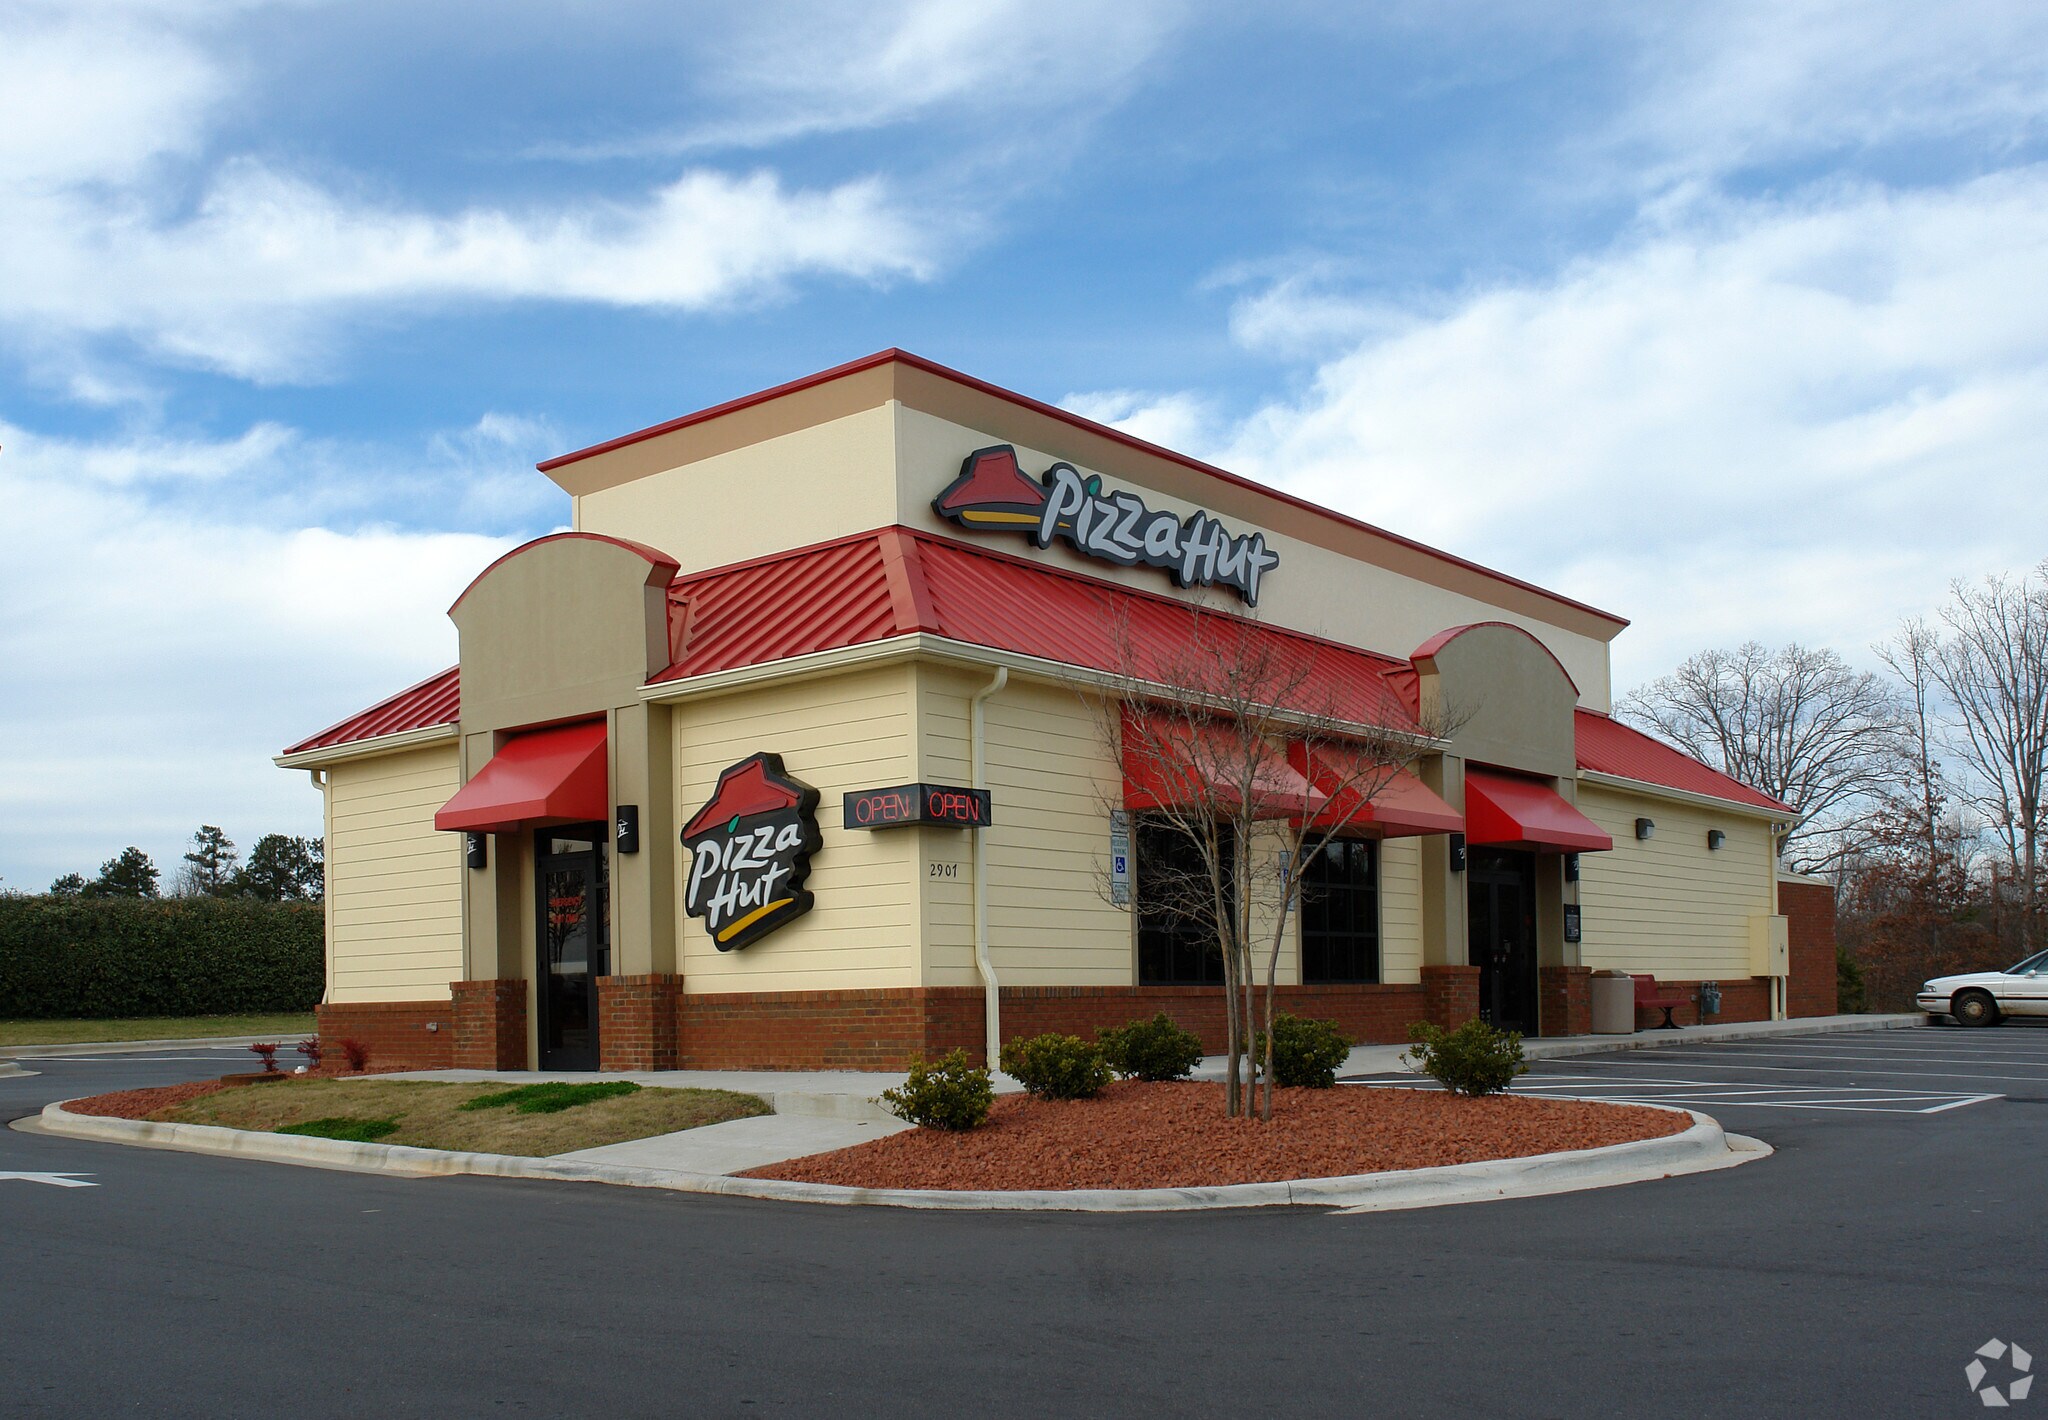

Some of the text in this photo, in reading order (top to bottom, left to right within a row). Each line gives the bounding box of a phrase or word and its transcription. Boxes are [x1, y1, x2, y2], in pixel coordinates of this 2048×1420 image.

[1041, 468, 1278, 601] Pizza Hut
[855, 794, 910, 823] OPEN
[929, 791, 979, 822] OPEN
[688, 815, 802, 909] Pizza
[707, 861, 790, 928] Hut
